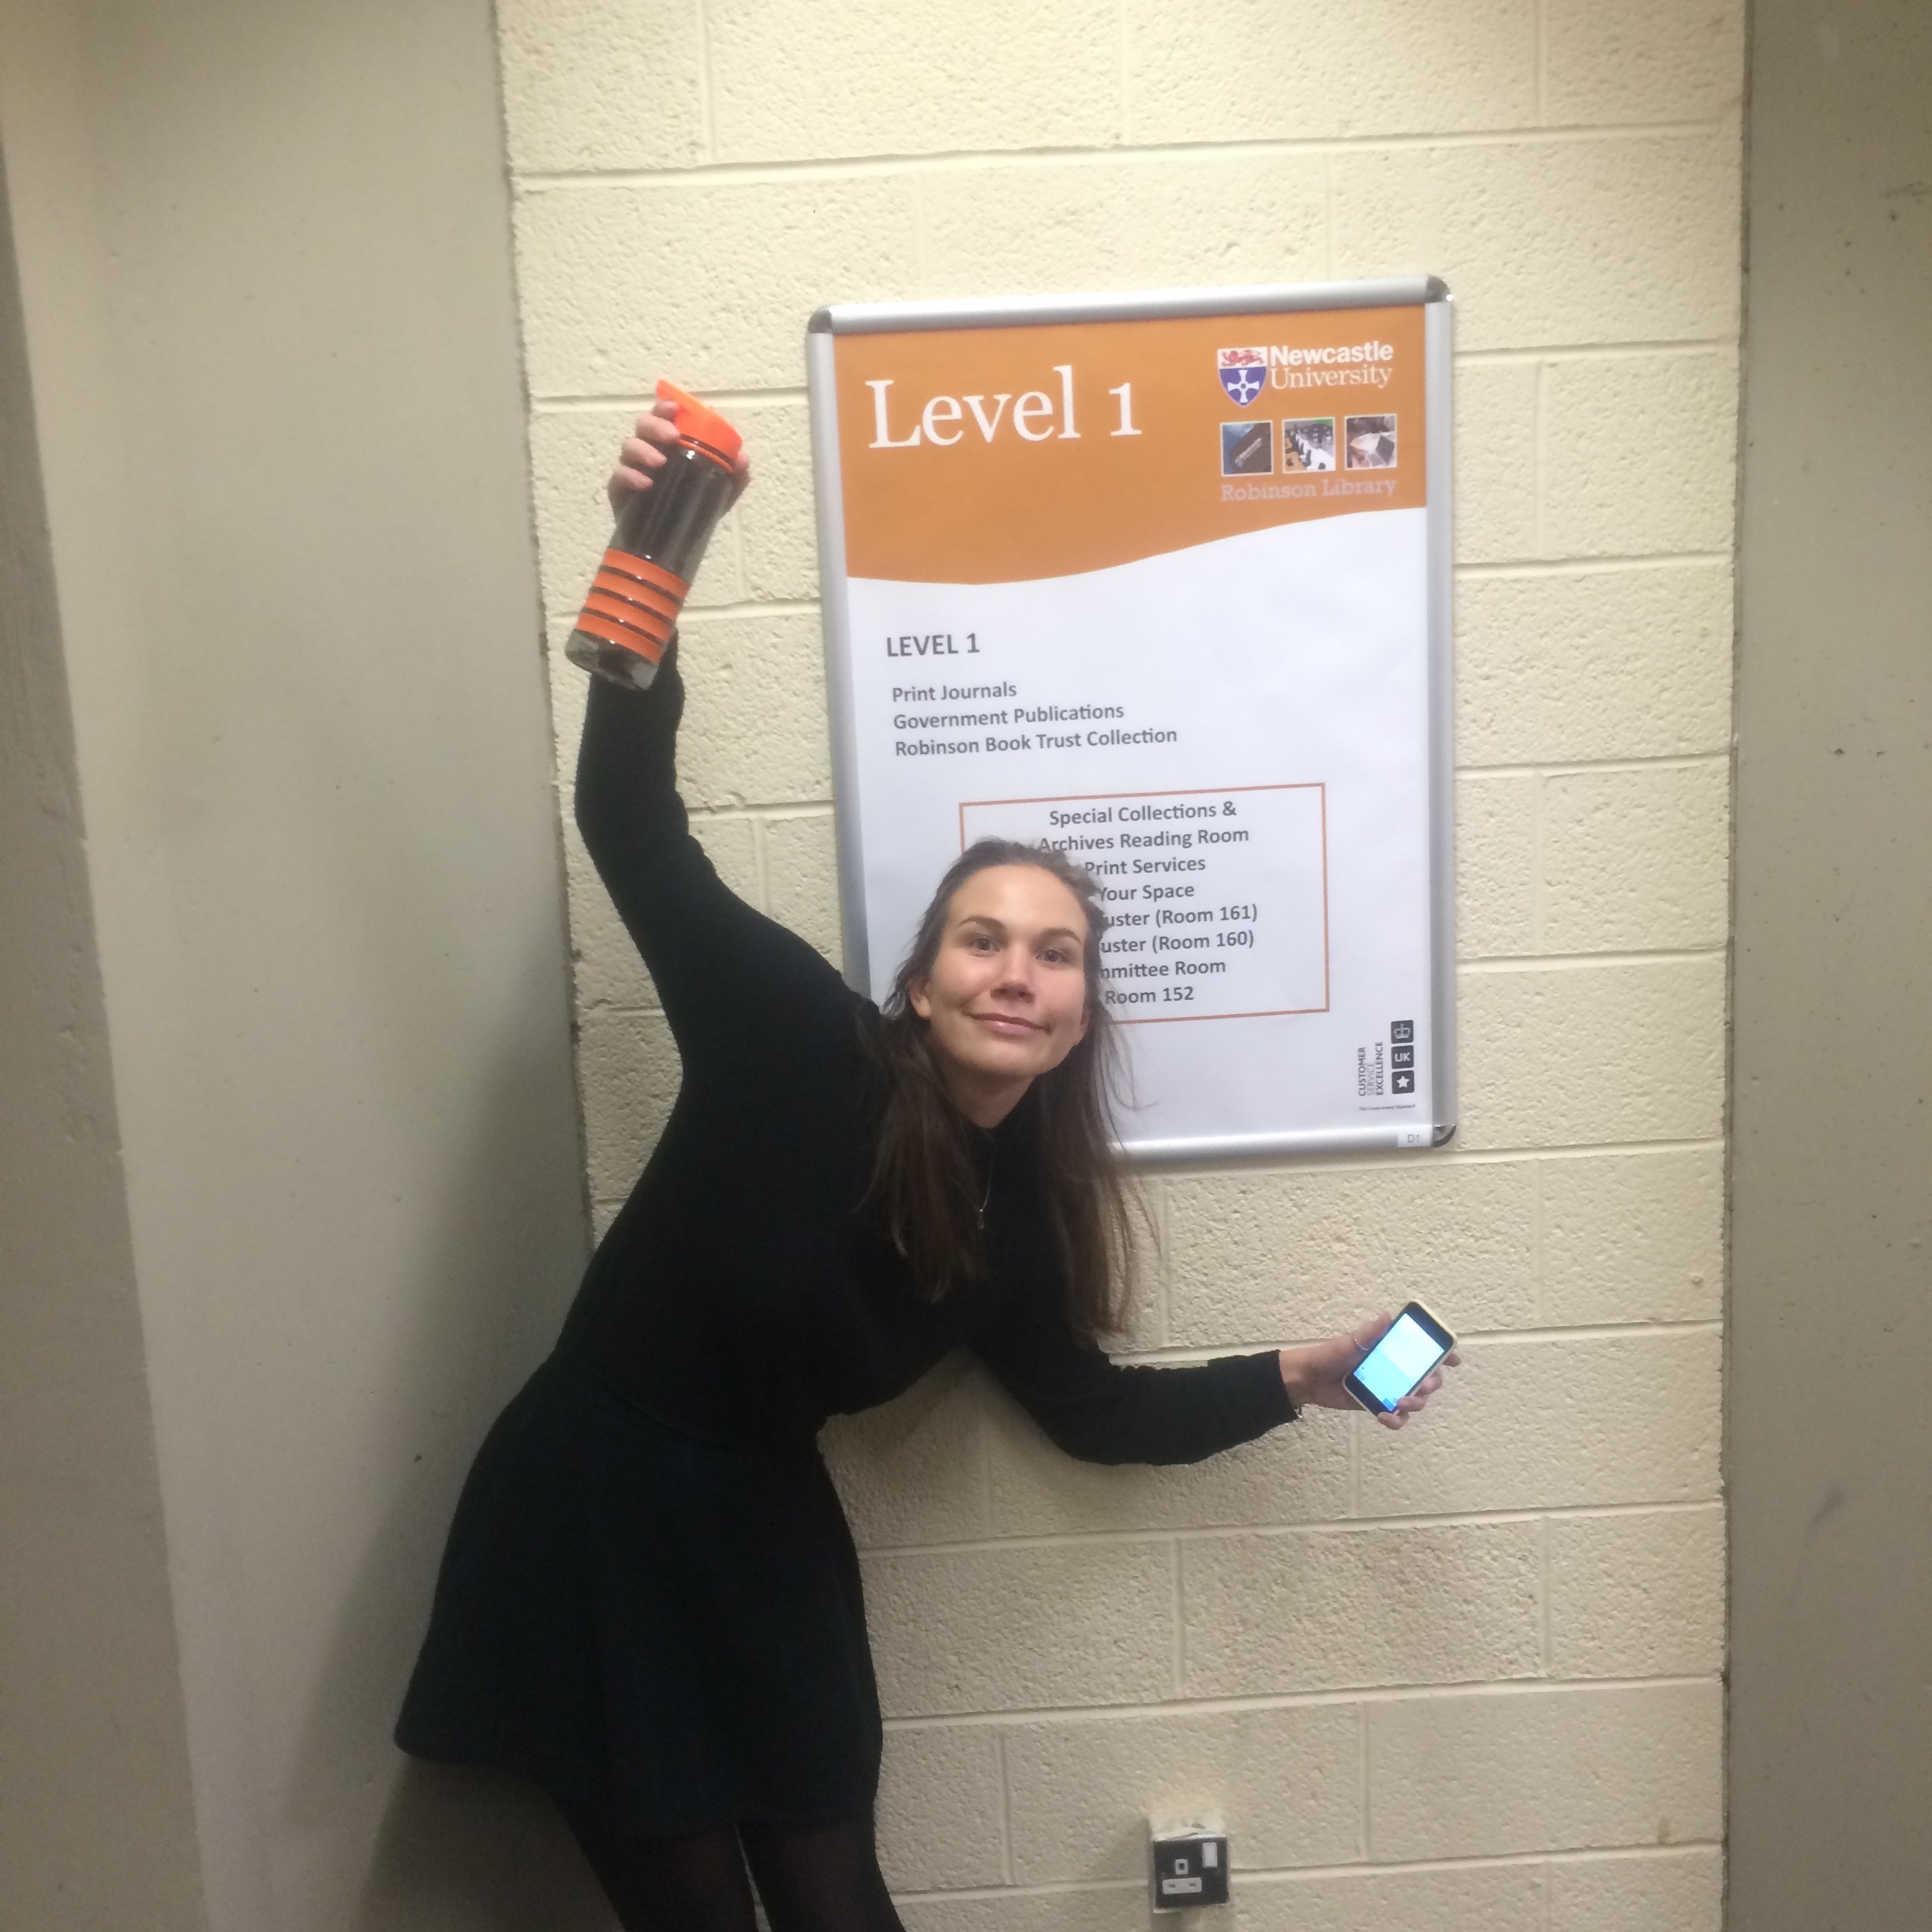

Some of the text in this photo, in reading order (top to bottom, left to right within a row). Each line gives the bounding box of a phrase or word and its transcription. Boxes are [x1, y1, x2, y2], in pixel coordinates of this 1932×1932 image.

[1271, 340, 1394, 366] Newcastle
[1271, 364, 1393, 389] University
[866, 365, 1143, 448] Level 1
[1220, 479, 1397, 502] Robinson Library
[886, 633, 980, 657] LEVEL 1
[892, 682, 1017, 702] Print Journals
[893, 704, 1125, 729] Government Publications
[895, 728, 1178, 756] Robinson Book Trust Collection
[1049, 801, 1237, 829] Special Collections &
[1040, 829, 1249, 852] Archives Reading Room
[1085, 857, 1206, 875] Print Services
[1143, 885, 1195, 902] Space
[1105, 904, 1258, 928] uster (Room 161)
[1100, 930, 1255, 955] uster (Room 160)
[1175, 960, 1226, 975] Room
[1105, 986, 1194, 1005] Room 152
[1375, 1042, 1383, 1095] EXCELLENCE
[1395, 1052, 1410, 1062] UK
